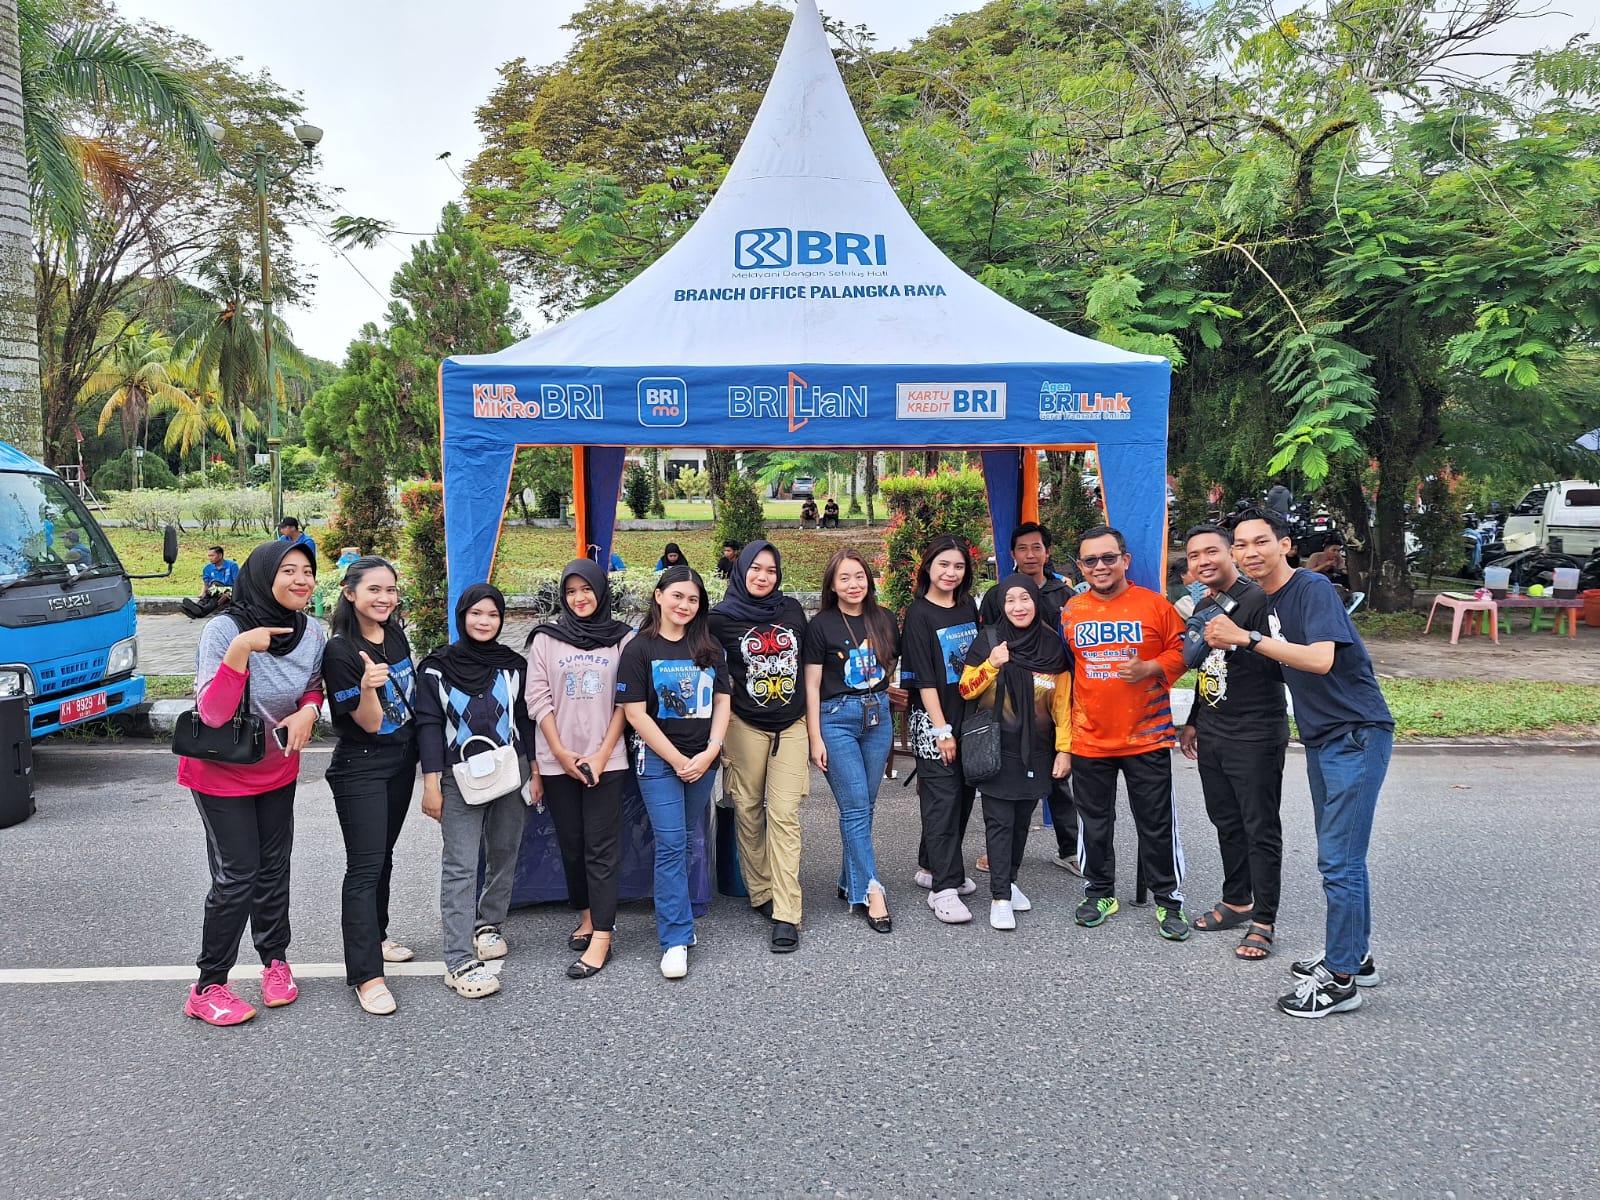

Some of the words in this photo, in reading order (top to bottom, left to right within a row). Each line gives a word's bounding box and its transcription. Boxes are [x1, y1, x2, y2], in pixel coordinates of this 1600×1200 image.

[797, 230, 887, 266] BRI
[782, 270, 826, 278] Dengan
[674, 288, 746, 302] BRANCH
[749, 286, 807, 300] OFFICE
[810, 284, 900, 299] PALANGKA
[903, 284, 947, 297] RAYA
[472, 383, 516, 401] KUR
[646, 388, 678, 405] BRI
[907, 390, 950, 401] KARTU
[1040, 381, 1072, 394] Agen
[474, 401, 541, 418] MIKRO
[541, 384, 604, 420] BRI
[907, 402, 951, 413] KREDIT
[953, 389, 998, 413] BRI
[1039, 392, 1132, 412] BRILink
[652, 405, 680, 417] mo
[48, 593, 91, 611] ISUZU
[1100, 621, 1143, 643] BRI
[558, 654, 609, 667] SUMMER
[61, 702, 71, 716] KH
[76, 697, 93, 712] 8929
